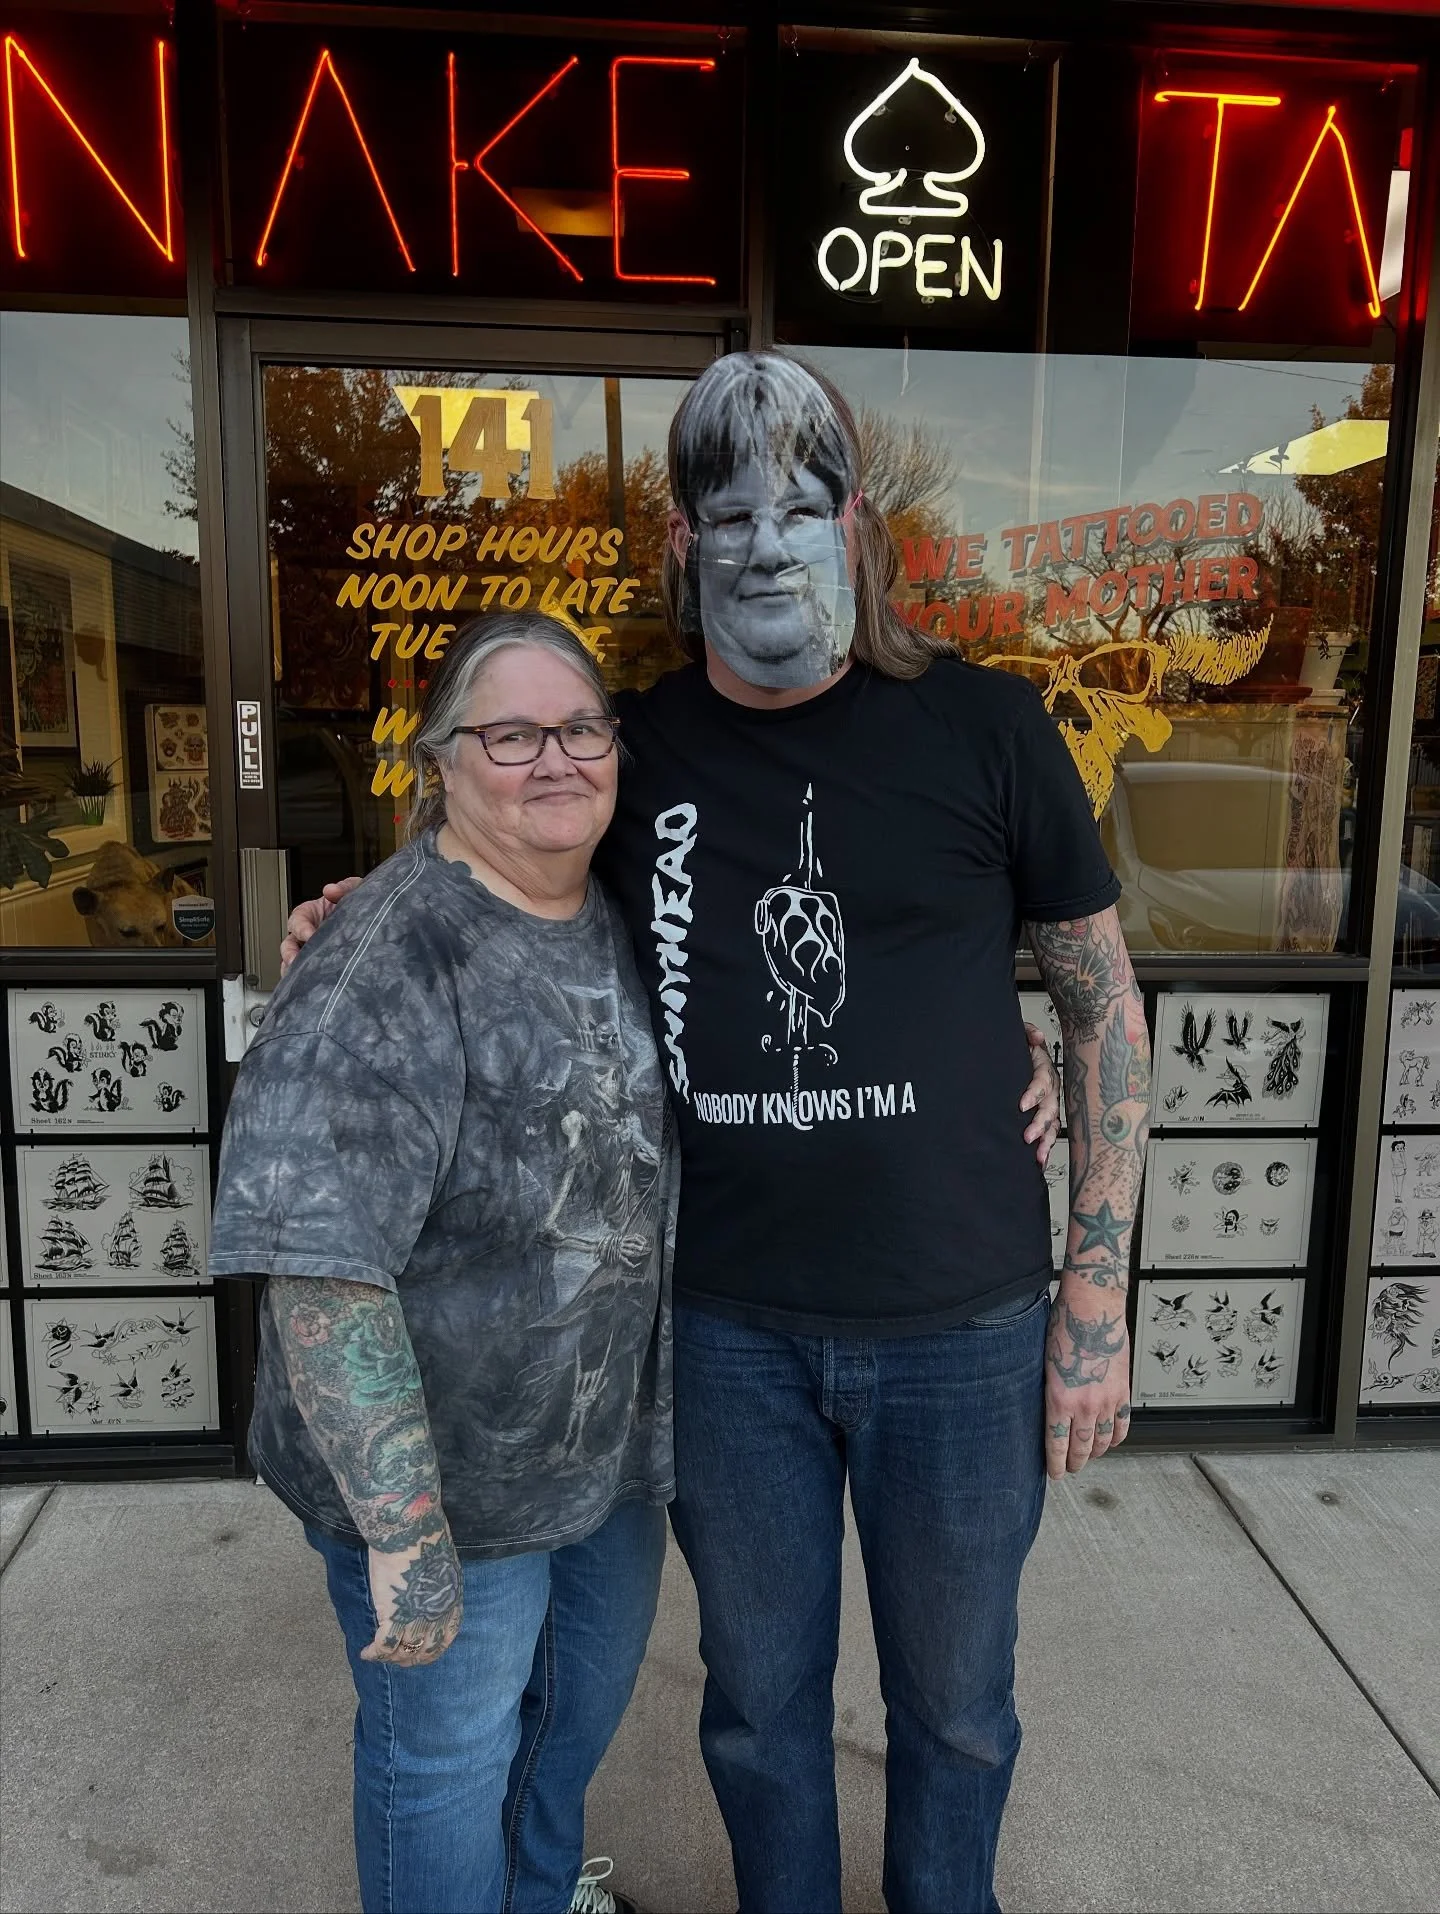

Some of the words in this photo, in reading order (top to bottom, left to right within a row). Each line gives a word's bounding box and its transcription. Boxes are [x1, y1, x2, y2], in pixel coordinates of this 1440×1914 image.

[1154, 90, 1382, 318] TA
[817, 227, 1003, 301] OPEN
[409, 394, 556, 500] 141
[346, 523, 467, 562] SHOP
[476, 526, 624, 567] HOURS
[902, 533, 987, 587] WE
[1001, 492, 1265, 575] TATTOOED
[336, 574, 468, 611] NOON
[481, 575, 531, 611] TO
[537, 577, 640, 615] LATE
[1044, 556, 1261, 632] MOTHER
[241, 704, 258, 769] PULL
[694, 1091, 757, 1124] NOBODY
[763, 1088, 851, 1124] KNOWS
[857, 1083, 896, 1118] I'M
[901, 1082, 917, 1113] A
